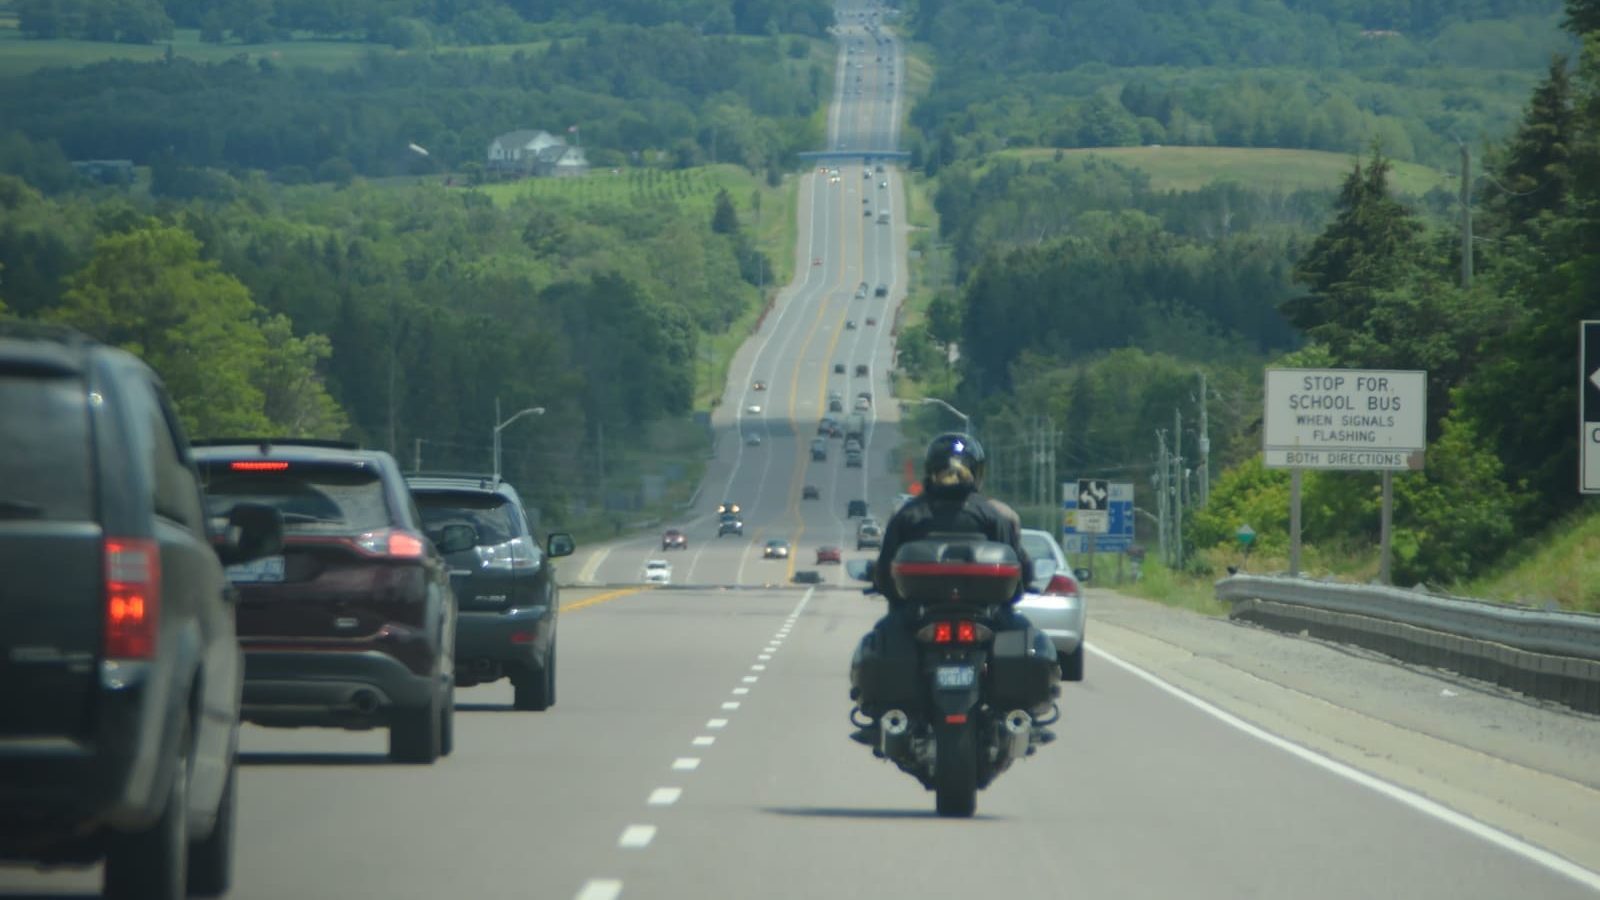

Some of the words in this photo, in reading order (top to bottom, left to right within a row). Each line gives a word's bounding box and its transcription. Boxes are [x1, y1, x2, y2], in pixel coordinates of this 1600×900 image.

[1304, 376, 1345, 391] STOP
[1357, 377, 1388, 392] FOR
[1289, 395, 1355, 410] SCHOOL
[1368, 396, 1401, 411] BUS
[1296, 415, 1332, 426] WHEN
[1341, 416, 1394, 427] SIGNALS
[1313, 430, 1376, 442] FLASHING
[1286, 452, 1319, 464] BOTH
[1328, 453, 1402, 465] DIRECTIONS
